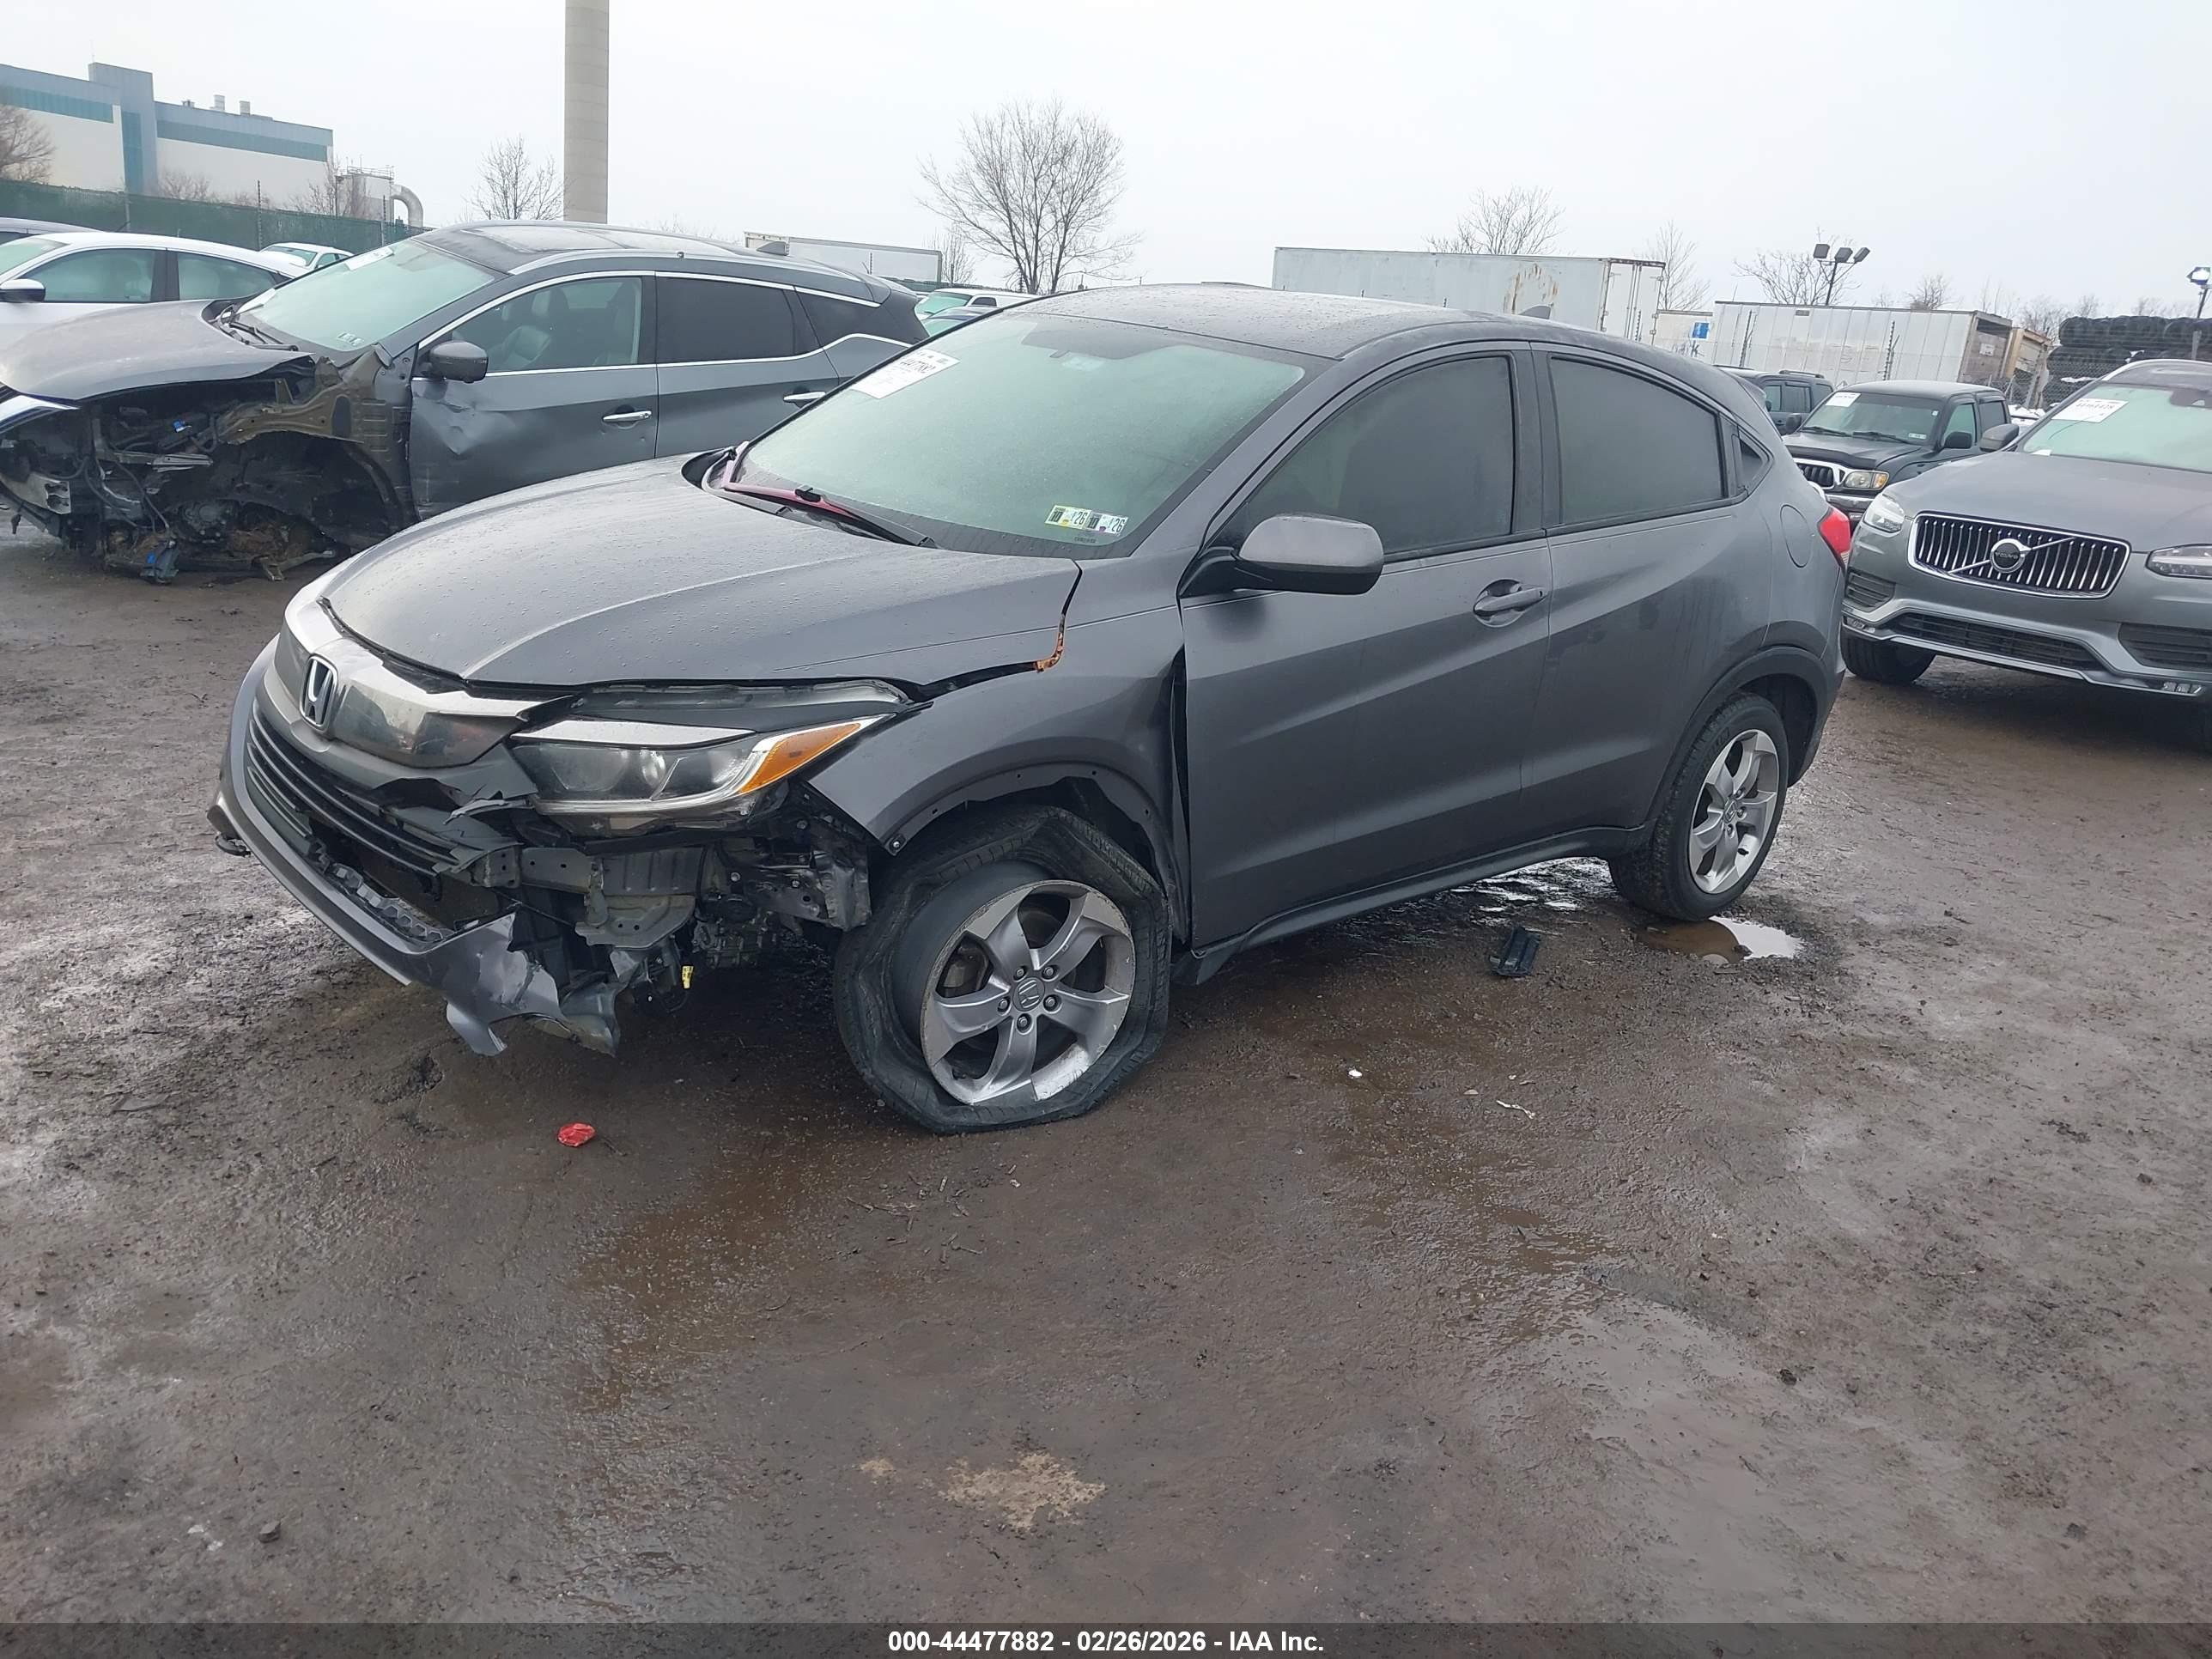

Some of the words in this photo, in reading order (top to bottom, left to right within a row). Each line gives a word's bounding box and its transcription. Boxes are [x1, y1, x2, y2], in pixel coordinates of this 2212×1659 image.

[1048, 510, 1064, 523] 10
[1073, 511, 1088, 526] 26
[1087, 516, 1101, 529] 10
[1111, 518, 1126, 532] 26
